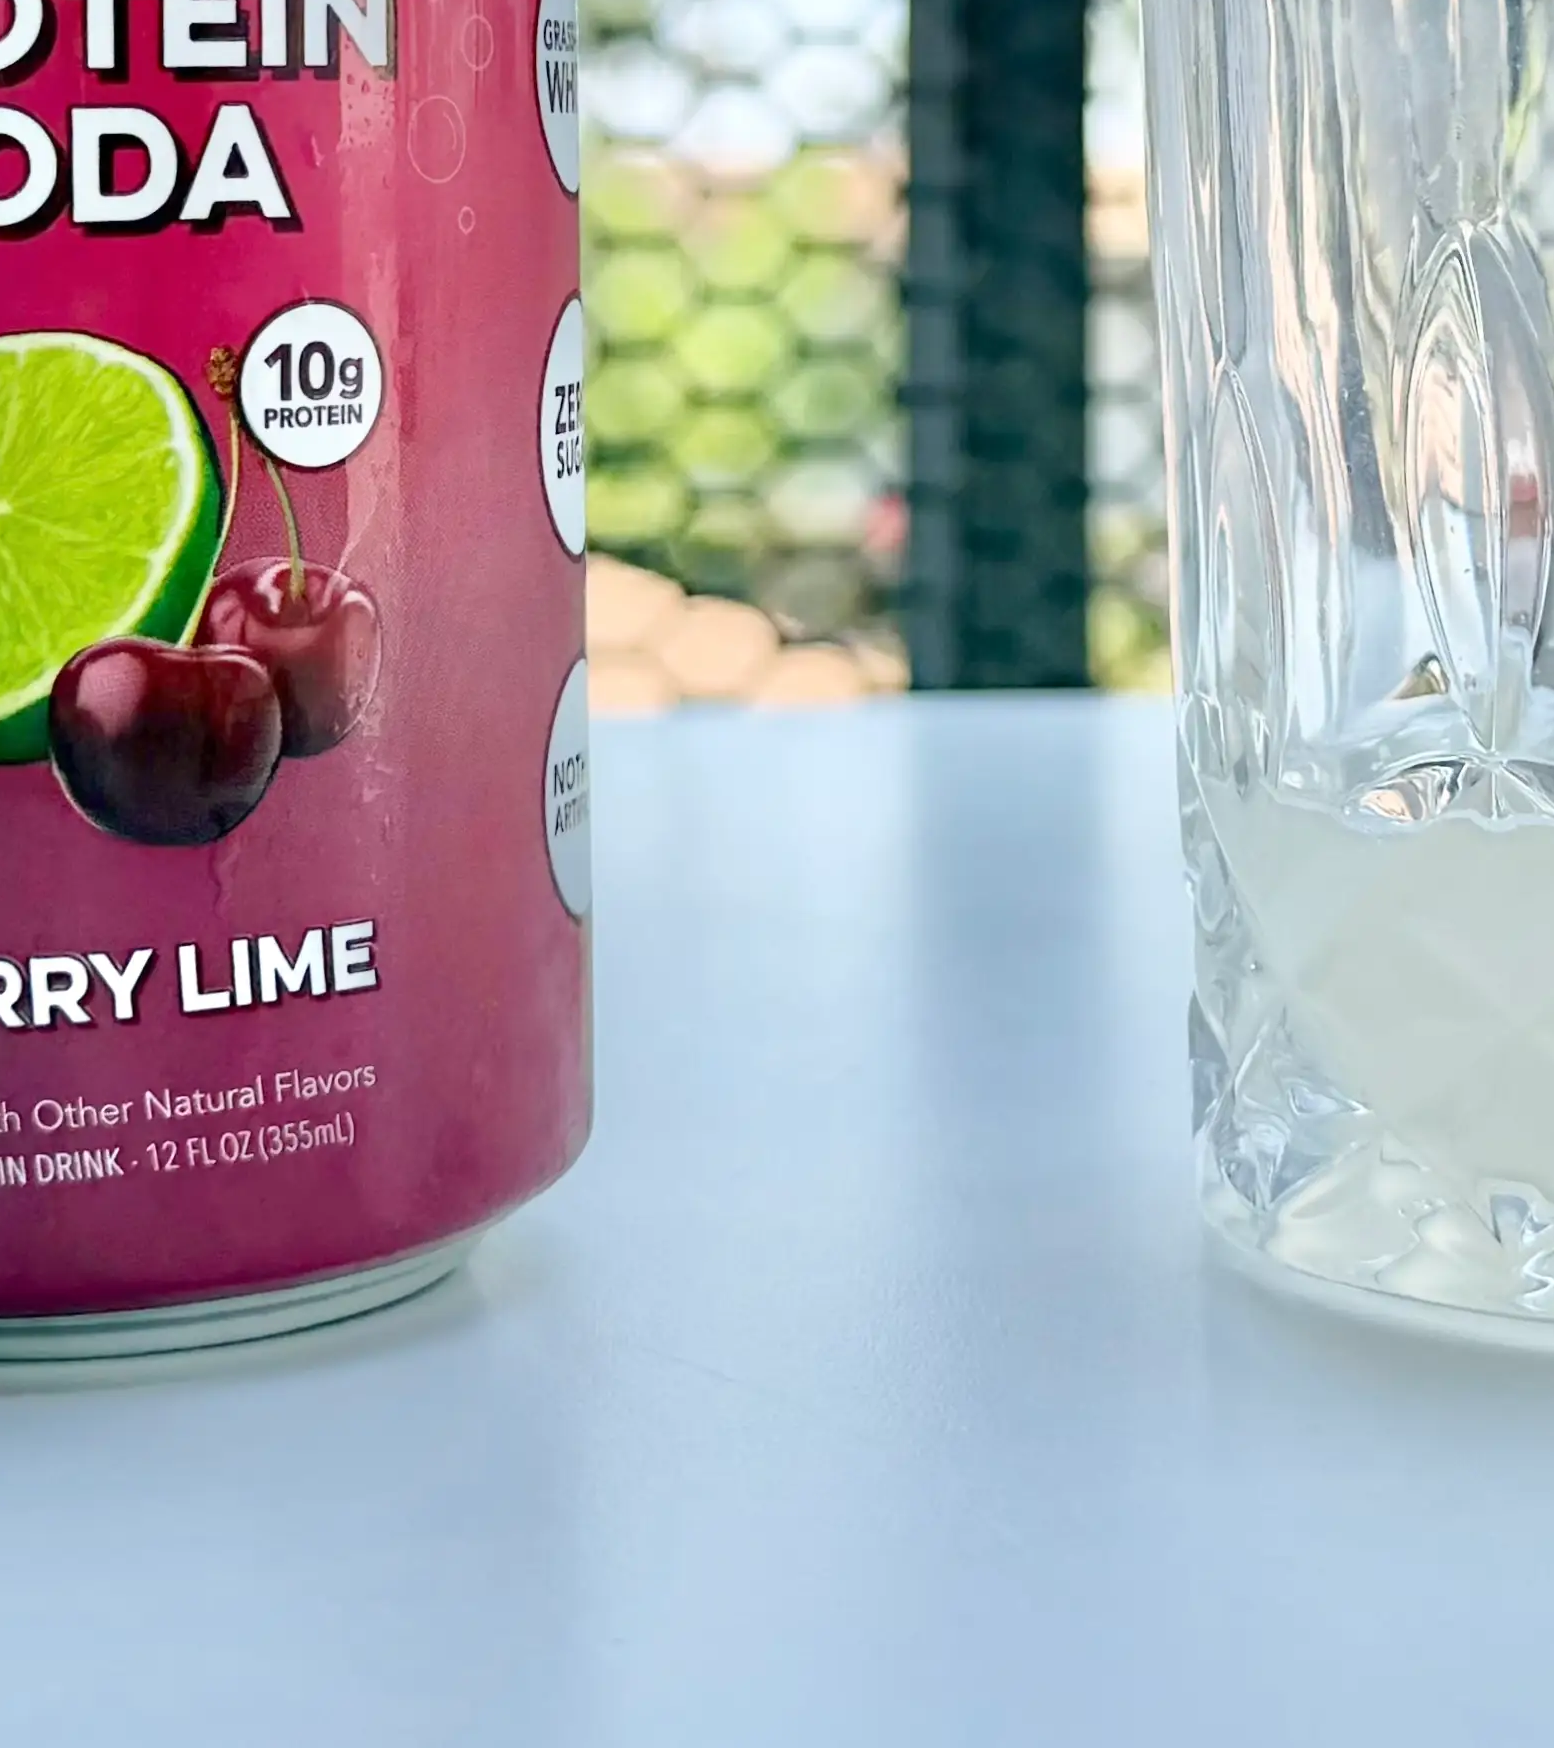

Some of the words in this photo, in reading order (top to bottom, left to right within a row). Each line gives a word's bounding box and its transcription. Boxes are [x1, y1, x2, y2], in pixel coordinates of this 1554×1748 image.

[264, 340, 363, 401] 10g
[264, 404, 363, 430] PROTEIN
[179, 920, 377, 1015] LIME
[31, 1098, 133, 1132] Other
[145, 1077, 264, 1121] Natural
[275, 1064, 377, 1106] Flavors
[37, 1148, 124, 1183] DRINK
[147, 1142, 179, 1172] 12
[186, 1137, 215, 1168] FL
[219, 1131, 254, 1164] OZ
[258, 1112, 356, 1160] (355mL)
